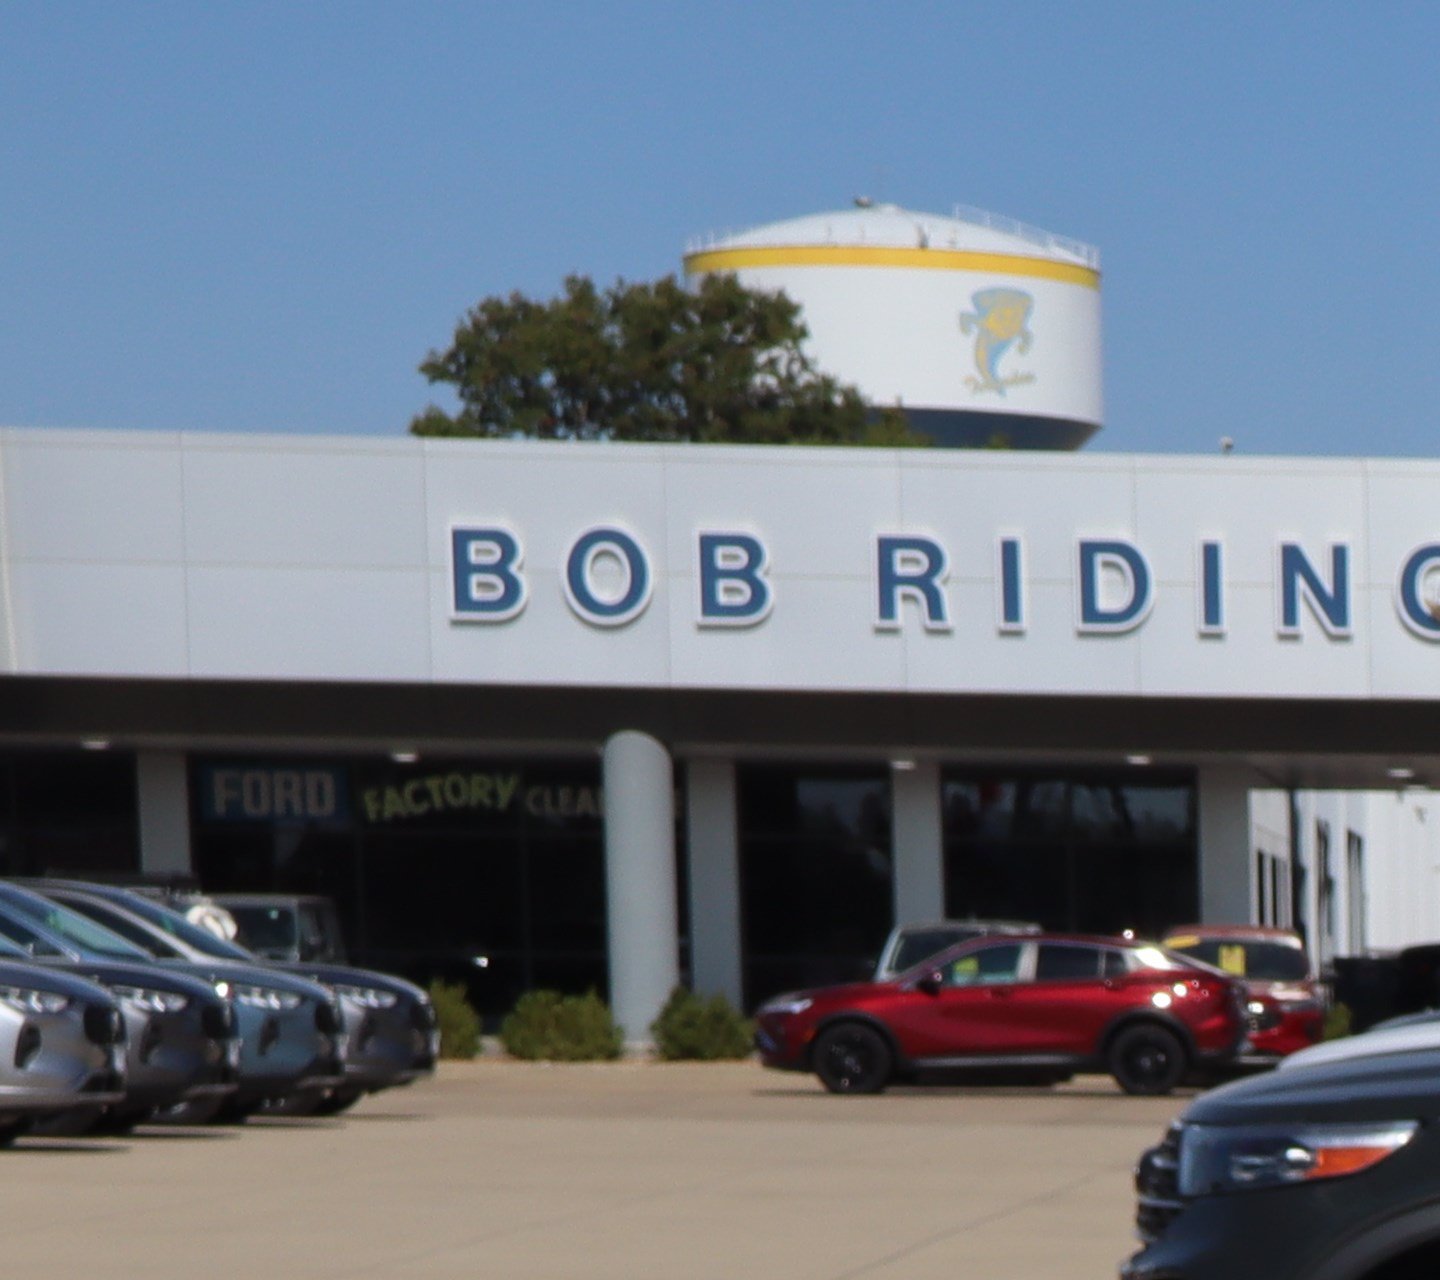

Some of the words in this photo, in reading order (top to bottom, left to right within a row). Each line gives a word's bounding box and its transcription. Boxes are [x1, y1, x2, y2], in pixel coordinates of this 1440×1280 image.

[448, 525, 773, 624] BOB
[211, 769, 336, 817] FORD
[362, 773, 519, 823] FACTORY
